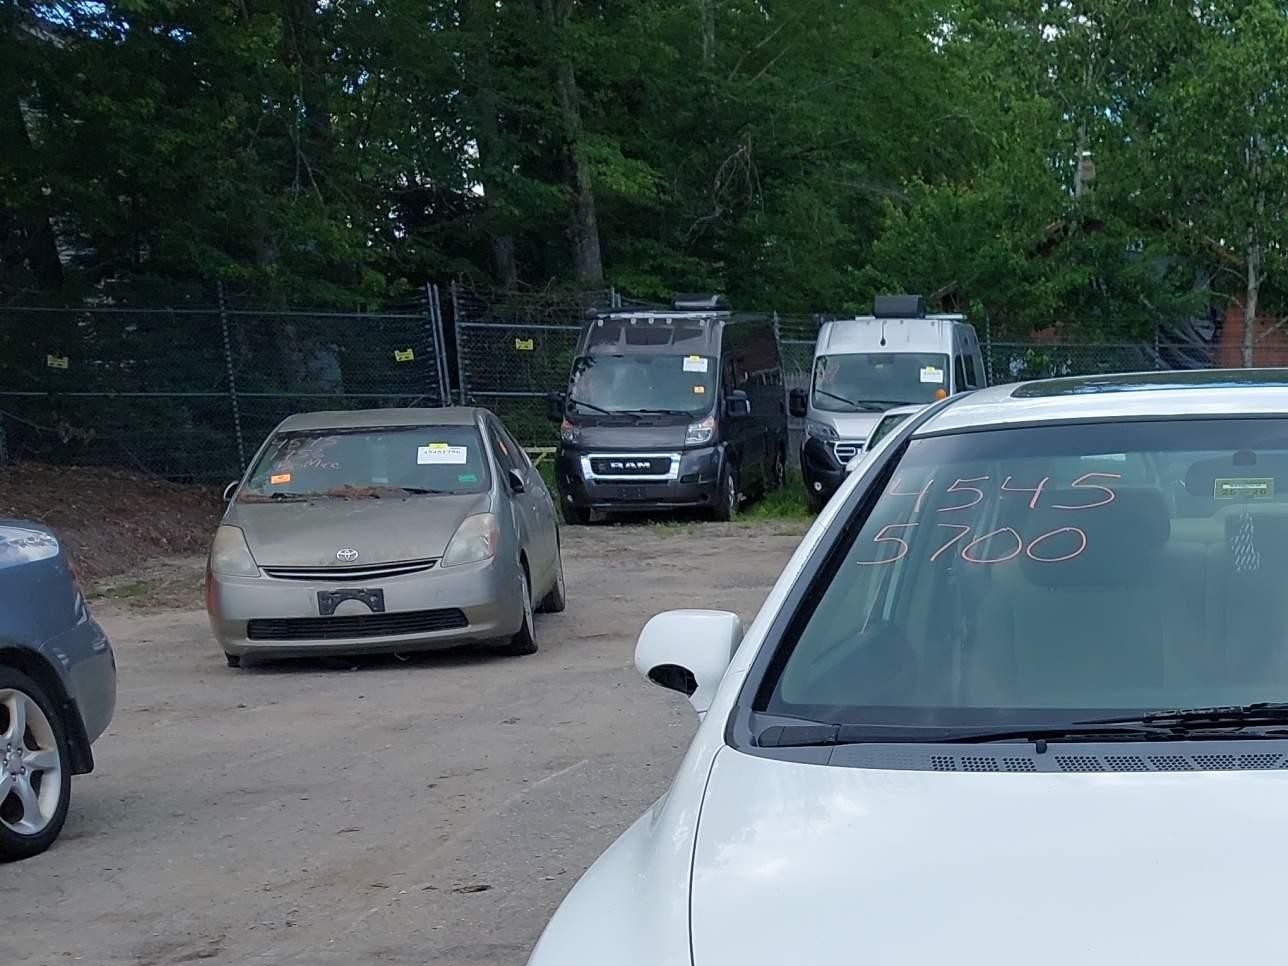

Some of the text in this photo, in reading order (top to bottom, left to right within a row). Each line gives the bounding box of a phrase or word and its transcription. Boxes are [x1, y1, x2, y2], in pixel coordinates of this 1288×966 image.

[610, 461, 651, 470] RAM
[889, 472, 1121, 513] 4545
[856, 522, 1087, 563] 5700
